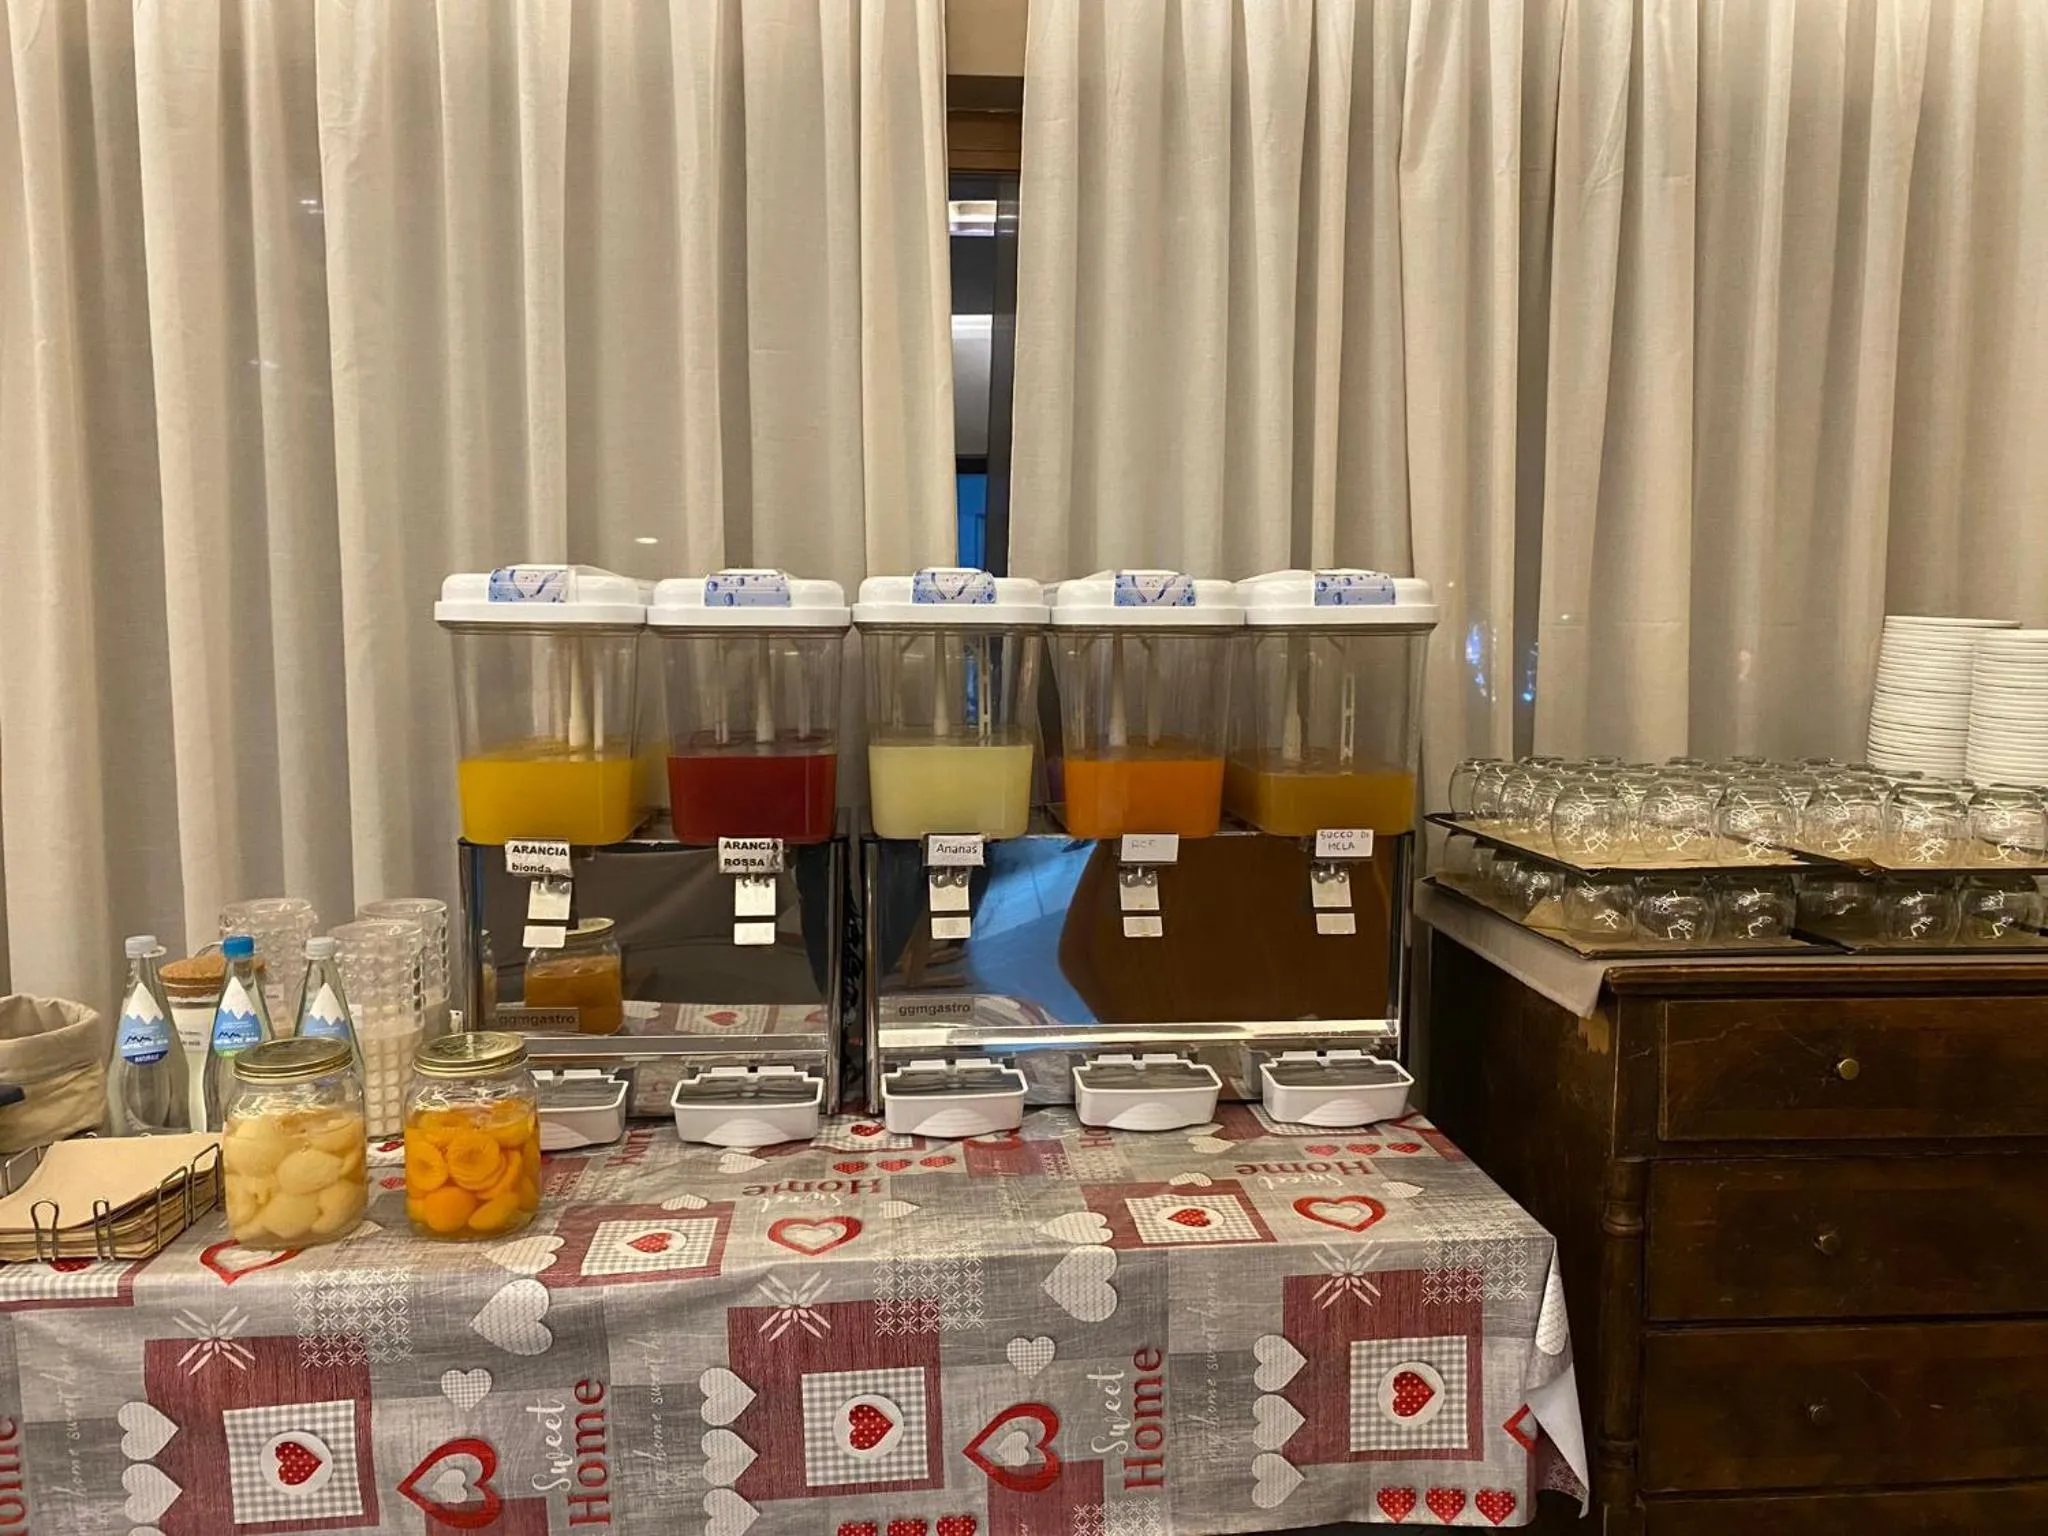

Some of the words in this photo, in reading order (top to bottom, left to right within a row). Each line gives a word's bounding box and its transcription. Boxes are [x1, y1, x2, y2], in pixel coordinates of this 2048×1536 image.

[1320, 831, 1354, 840] SUCCO
[512, 845, 567, 856] ARANCIA
[724, 841, 779, 850] ARANCIA
[936, 843, 978, 854] Ananas
[512, 863, 552, 873] bionda
[724, 858, 765, 866] ROSSA
[898, 1002, 971, 1016] ggmgastro
[1234, 1160, 1374, 1176] Home
[742, 1178, 882, 1196] Home
[1086, 1366, 1131, 1454] Sweet
[1124, 1347, 1164, 1489] Home
[526, 1398, 573, 1491] Sweet
[567, 1379, 611, 1526] Home
